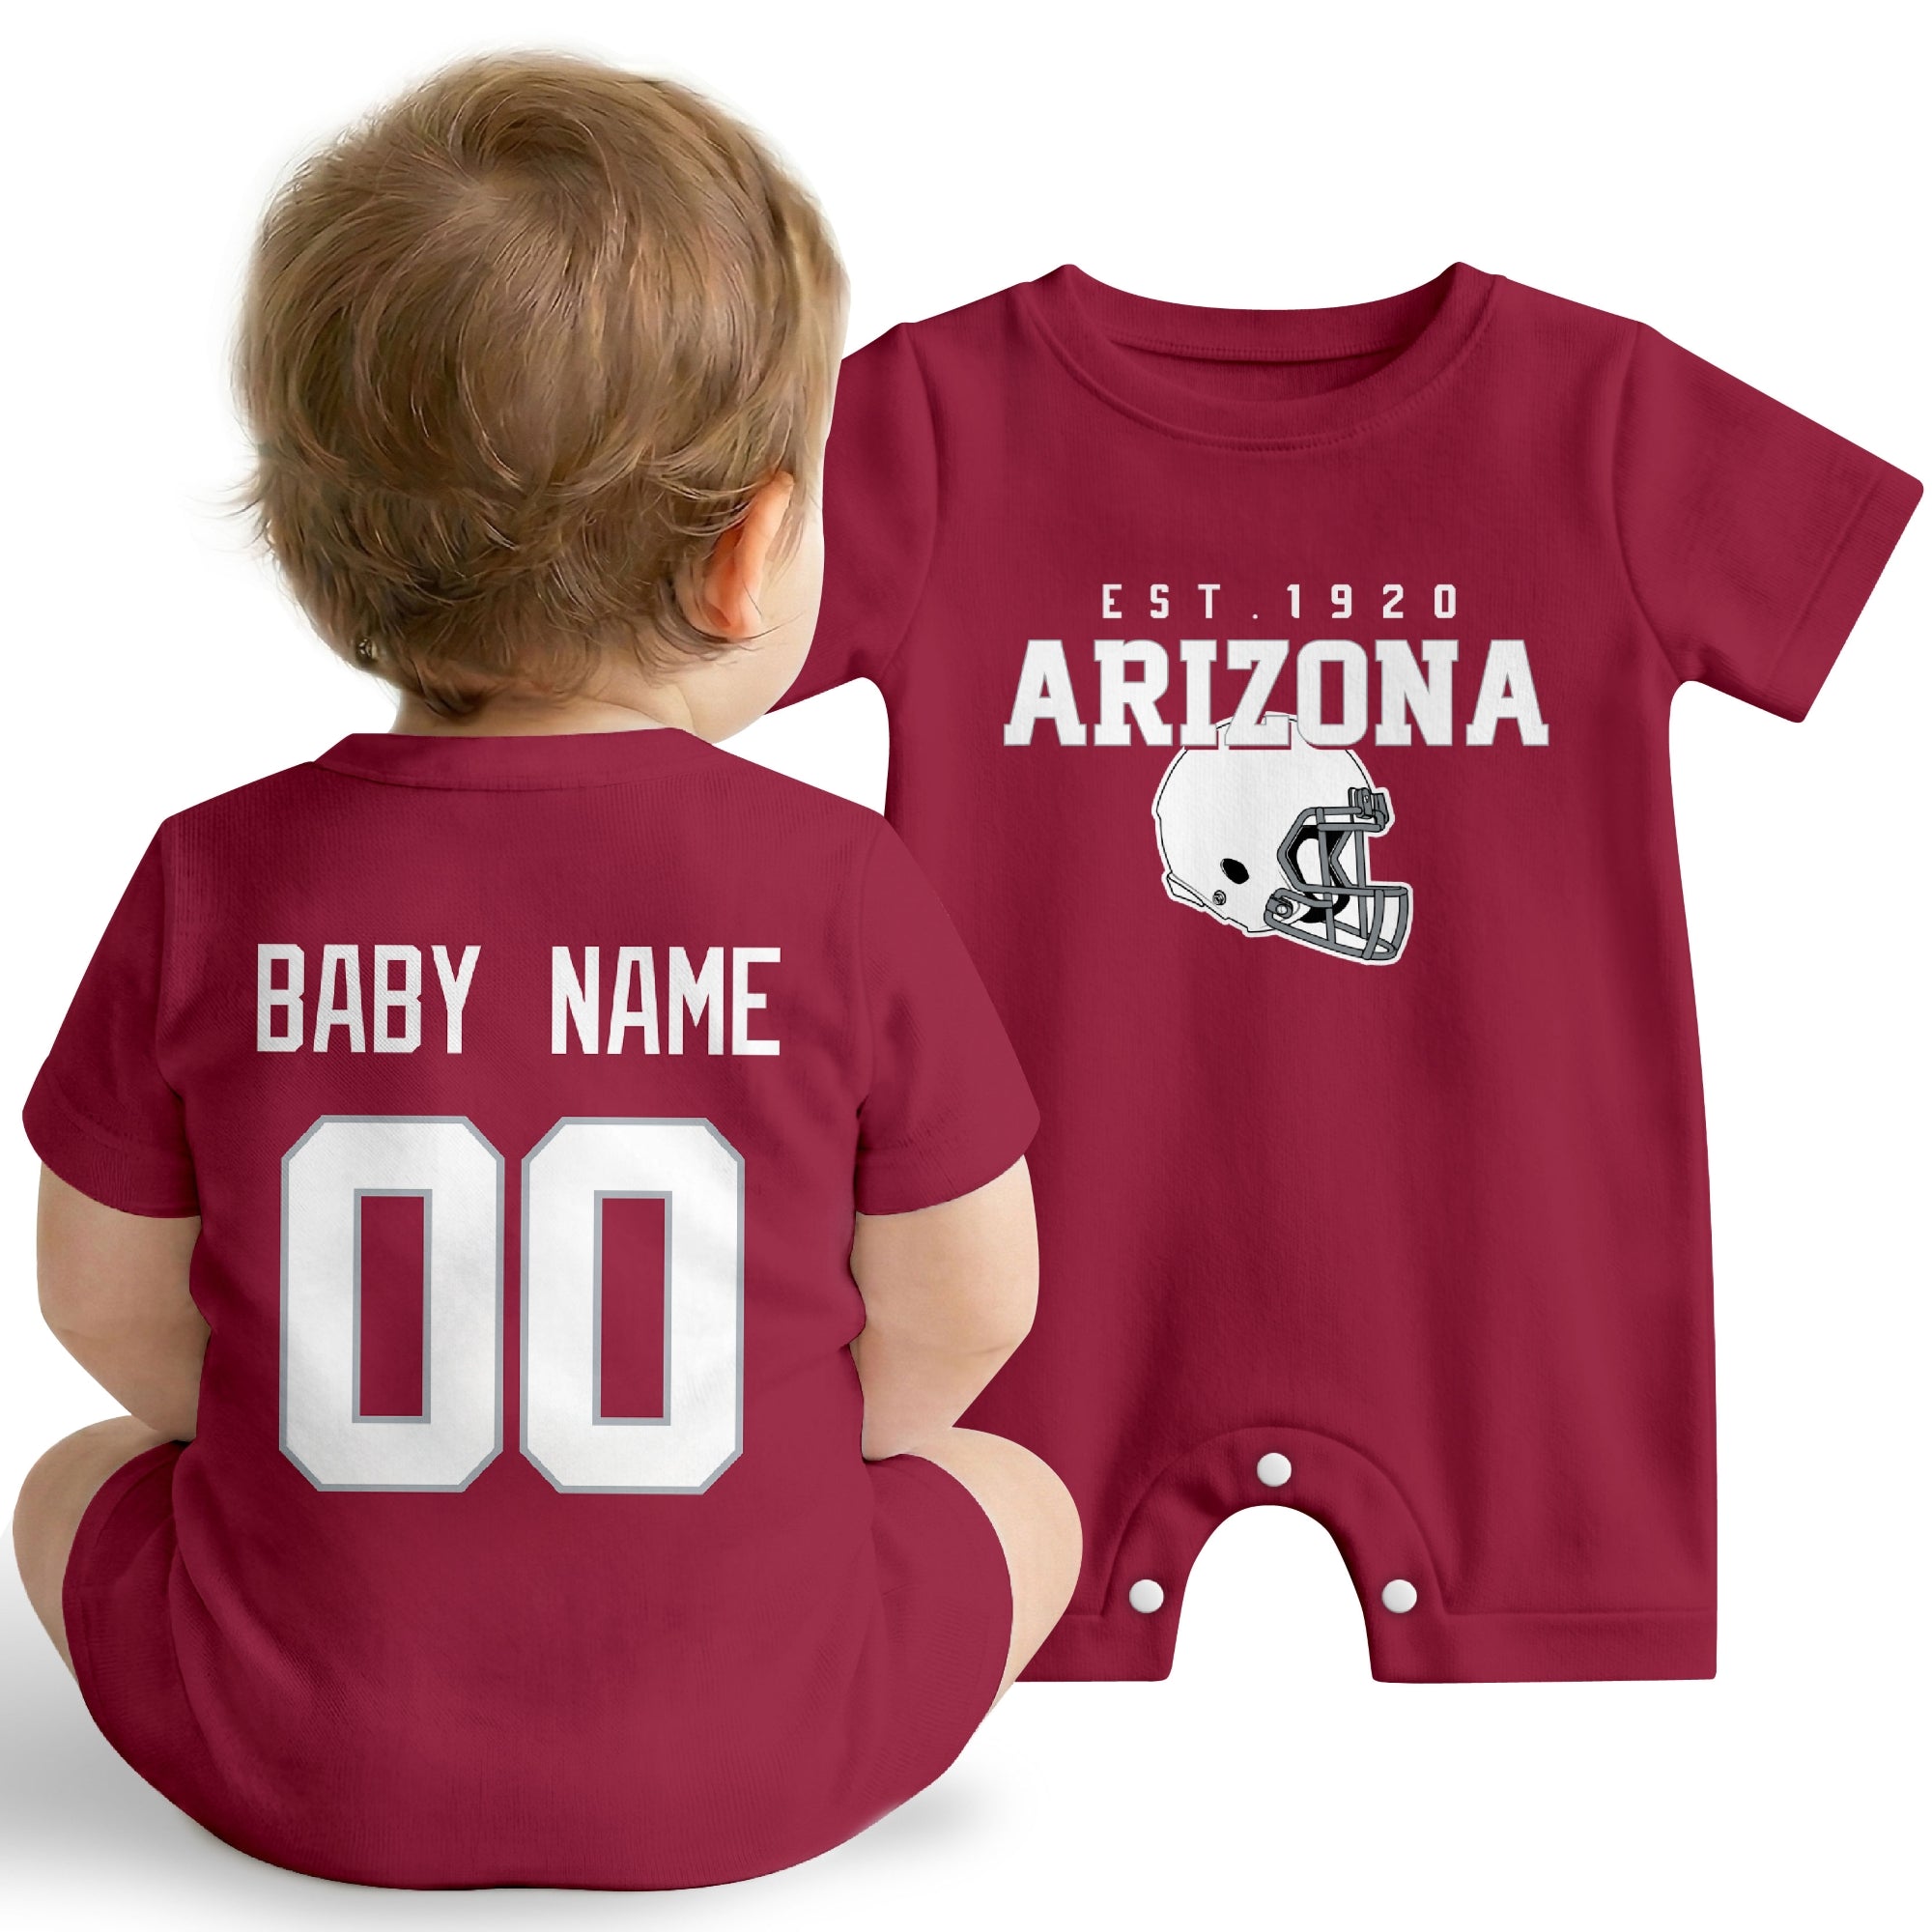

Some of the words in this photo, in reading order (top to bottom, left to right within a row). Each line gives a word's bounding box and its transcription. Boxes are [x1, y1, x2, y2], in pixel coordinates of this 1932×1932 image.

[1004, 639, 1549, 747] ARIZONA
[257, 943, 481, 1054] BABY
[551, 946, 781, 1056] NAME
[278, 1114, 746, 1495] 00
